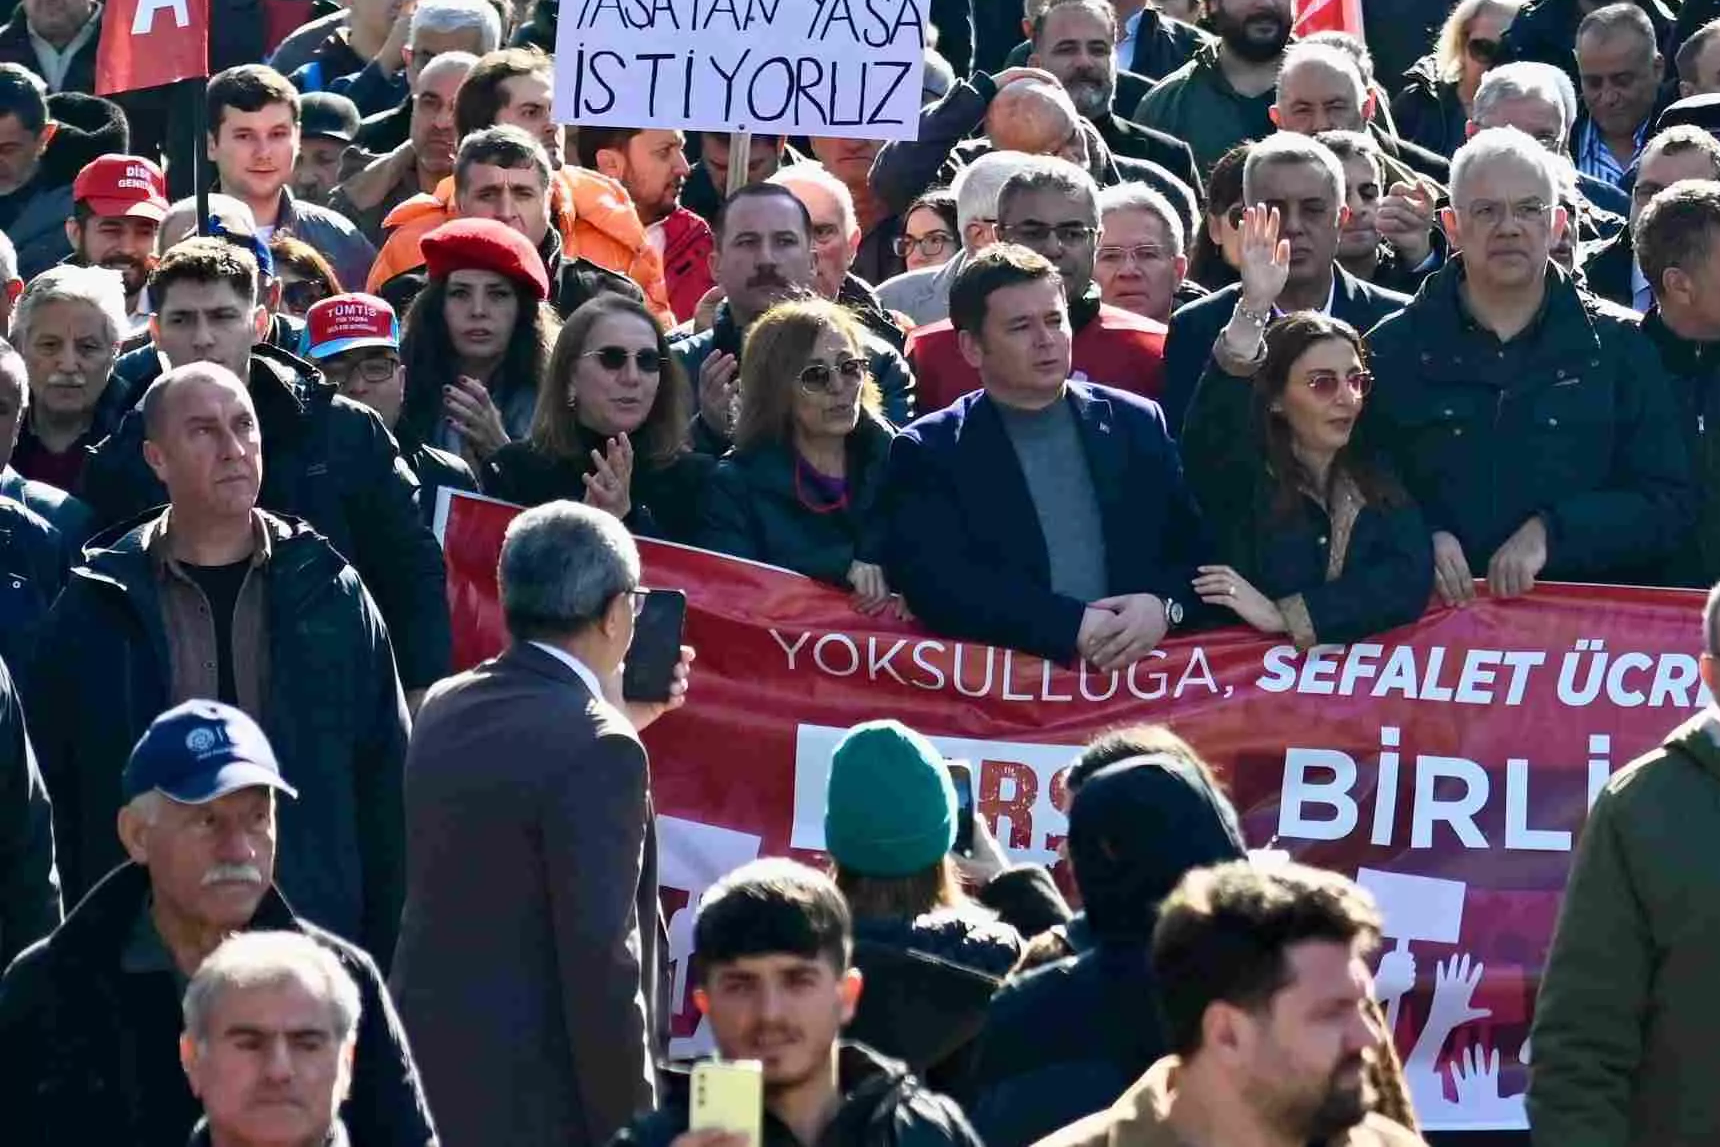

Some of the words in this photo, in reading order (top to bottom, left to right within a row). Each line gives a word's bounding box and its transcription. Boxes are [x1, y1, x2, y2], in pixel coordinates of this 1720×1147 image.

[573, 42, 913, 126] İSTİYORUZ
[1255, 642, 1543, 707] SEFALET
[1277, 726, 1610, 851] BİRLİ
